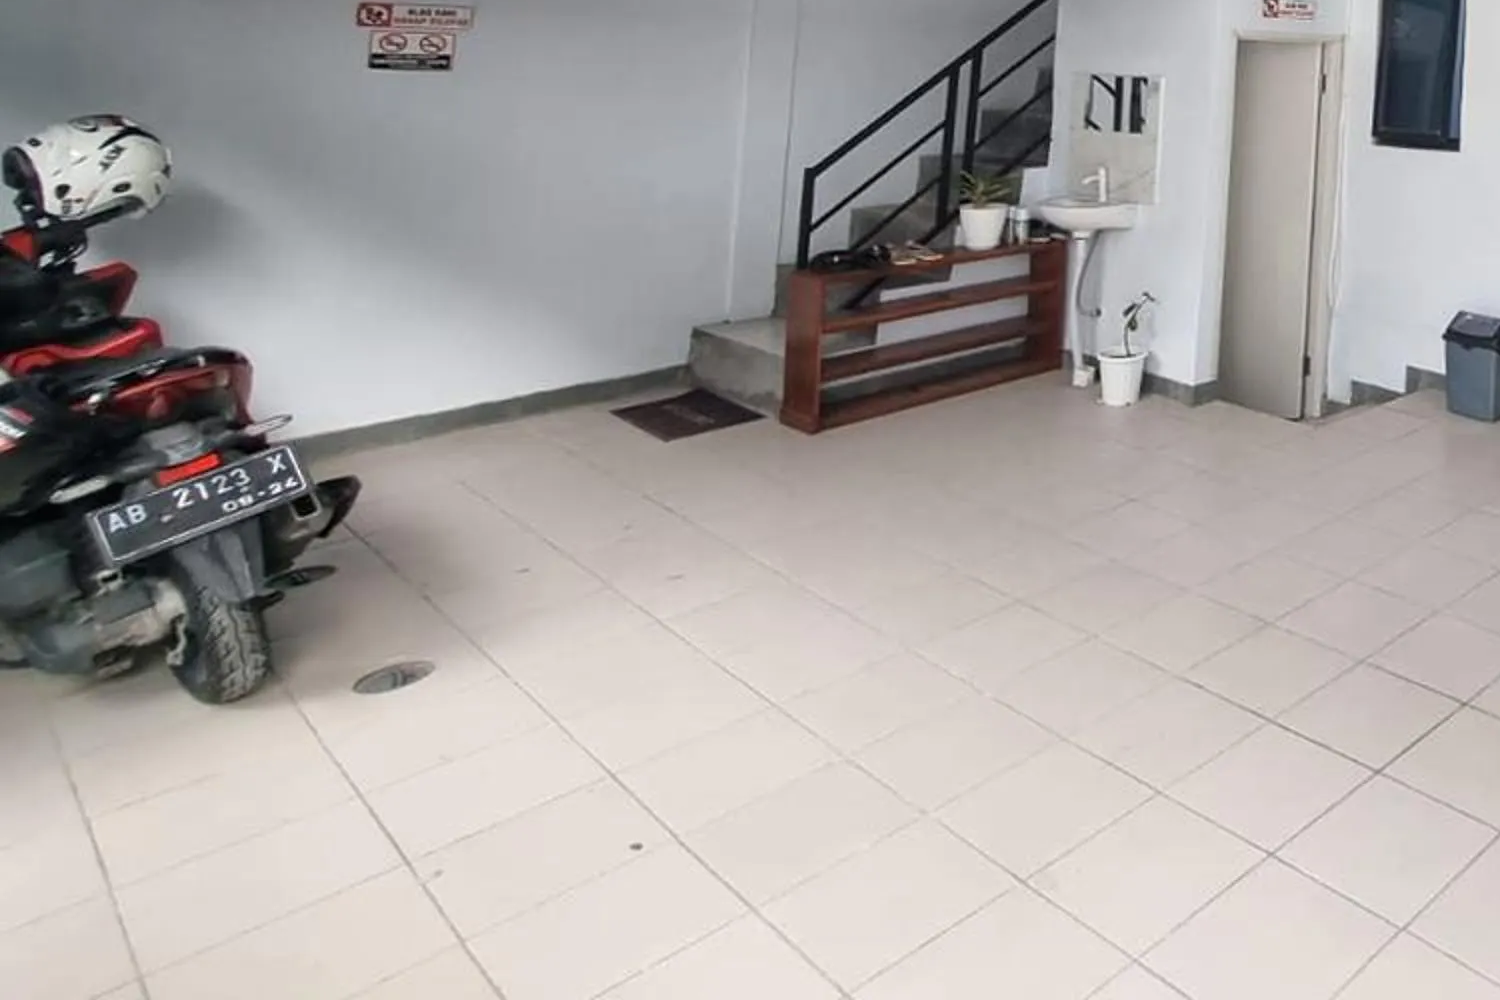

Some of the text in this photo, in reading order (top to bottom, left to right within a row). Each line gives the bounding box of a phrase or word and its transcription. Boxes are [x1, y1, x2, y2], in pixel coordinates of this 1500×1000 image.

[107, 453, 287, 533] AB 2123 X
